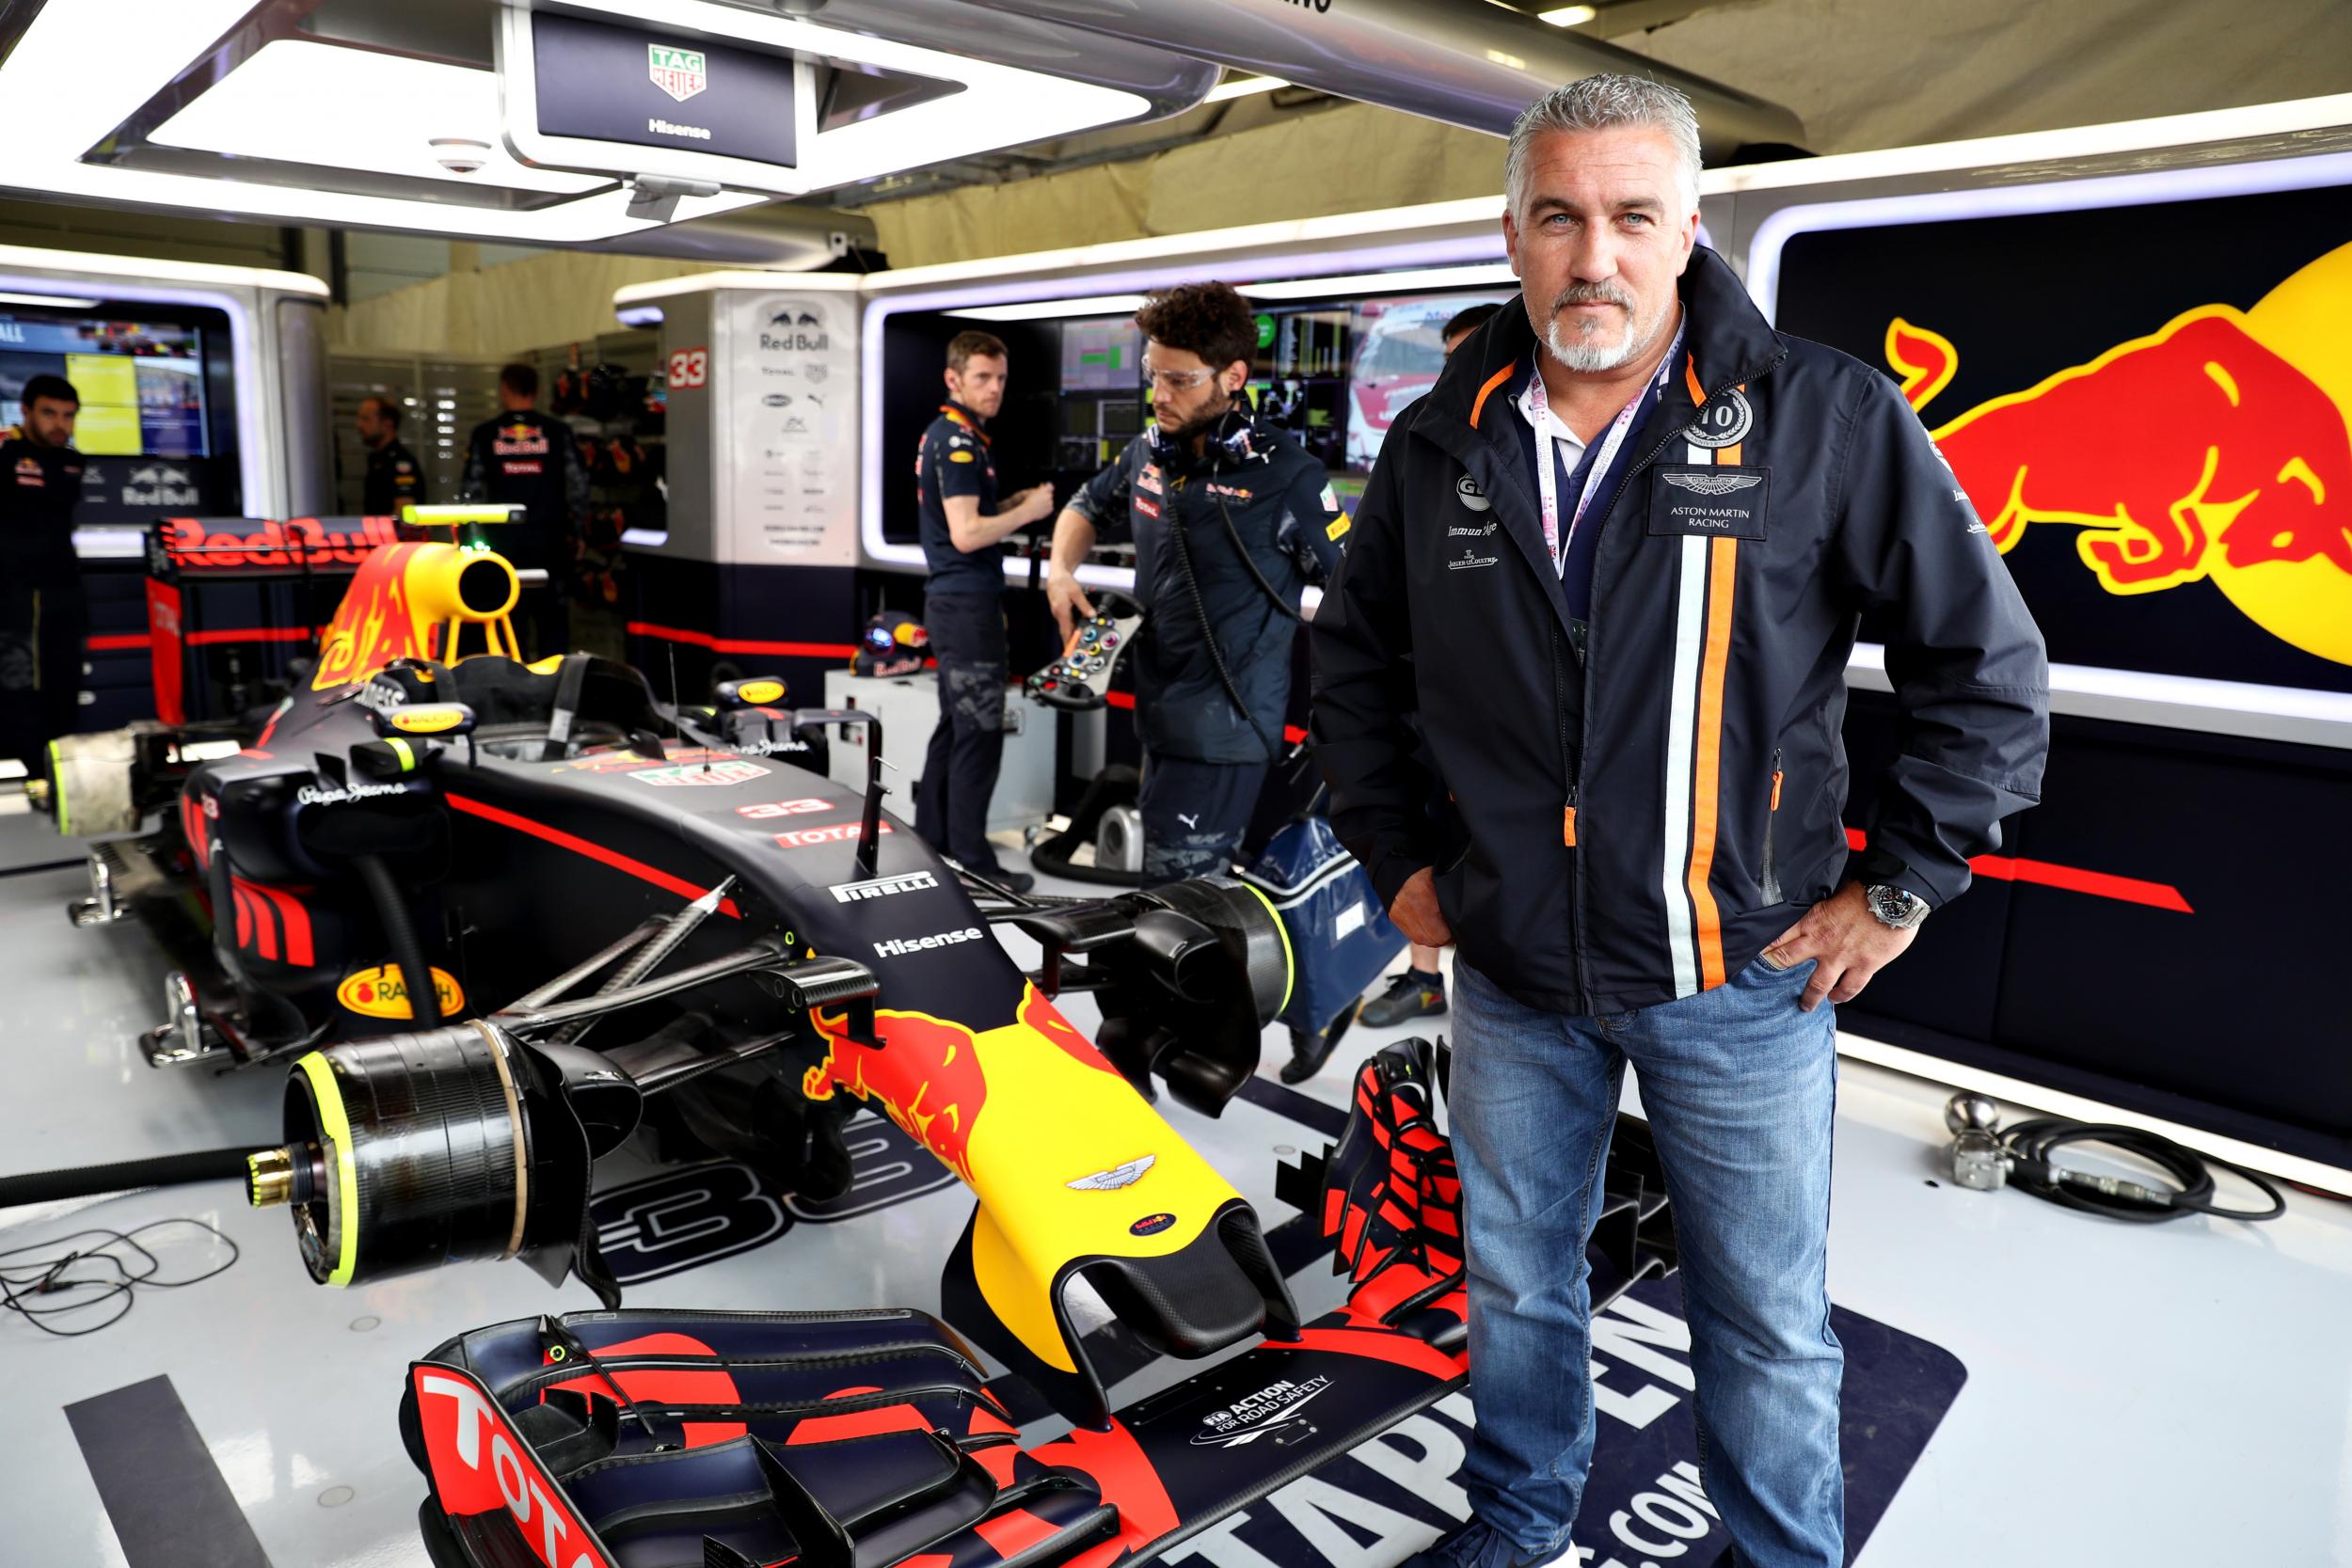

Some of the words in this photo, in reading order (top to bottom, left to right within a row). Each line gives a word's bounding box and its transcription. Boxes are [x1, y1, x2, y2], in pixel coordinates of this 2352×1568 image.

[653, 49, 704, 72] TAG
[652, 69, 705, 95] HEUER
[648, 119, 711, 140] Hisense
[760, 335, 792, 351] Red
[796, 334, 828, 351] Bull
[669, 348, 707, 388] 33
[122, 487, 160, 505] Red
[162, 487, 199, 505] Bull
[1670, 507, 1707, 516] ASTON
[1708, 508, 1750, 518] MARTIN
[1689, 518, 1729, 528] RACING
[160, 517, 294, 566] Red
[285, 517, 399, 563] Bull
[298, 785, 345, 805] Pepe
[346, 782, 407, 801] Jeans
[738, 798, 834, 819] 33
[828, 871, 939, 903] PIRELLI
[873, 927, 983, 958] Hisense
[378, 982, 452, 1004] RAH
[1203, 1412, 1231, 1426] FIA
[1230, 1380, 1296, 1415] ACTION
[1216, 1418, 1240, 1433] FOR
[1237, 1401, 1279, 1423] ROAD
[1277, 1374, 1328, 1404] SAFETY
[423, 1376, 594, 1568] TOT
